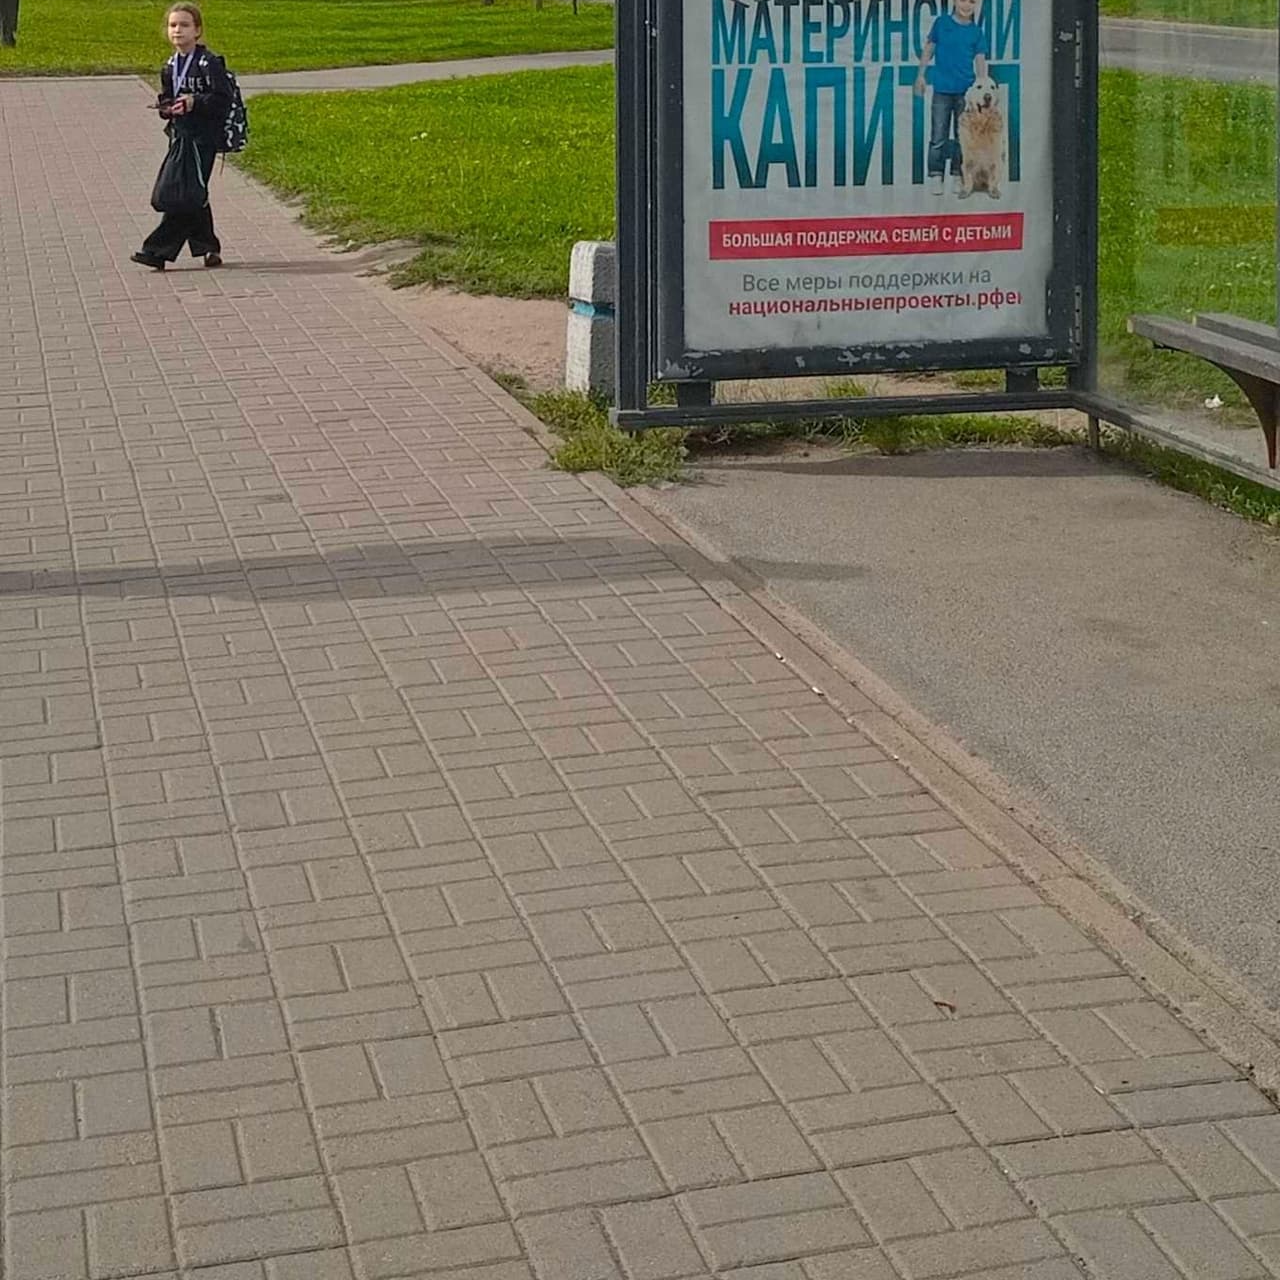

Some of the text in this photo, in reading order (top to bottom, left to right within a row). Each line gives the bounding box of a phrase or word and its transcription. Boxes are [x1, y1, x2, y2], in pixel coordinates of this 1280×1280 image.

[711, 63, 1021, 190] КАПИТЛ
[722, 224, 1012, 248] БОЛЬШАЯ ПОДДЕРЖКА СЕМЕЙ С ДЕТЬМИ
[742, 269, 991, 295] Все меры поддержки на
